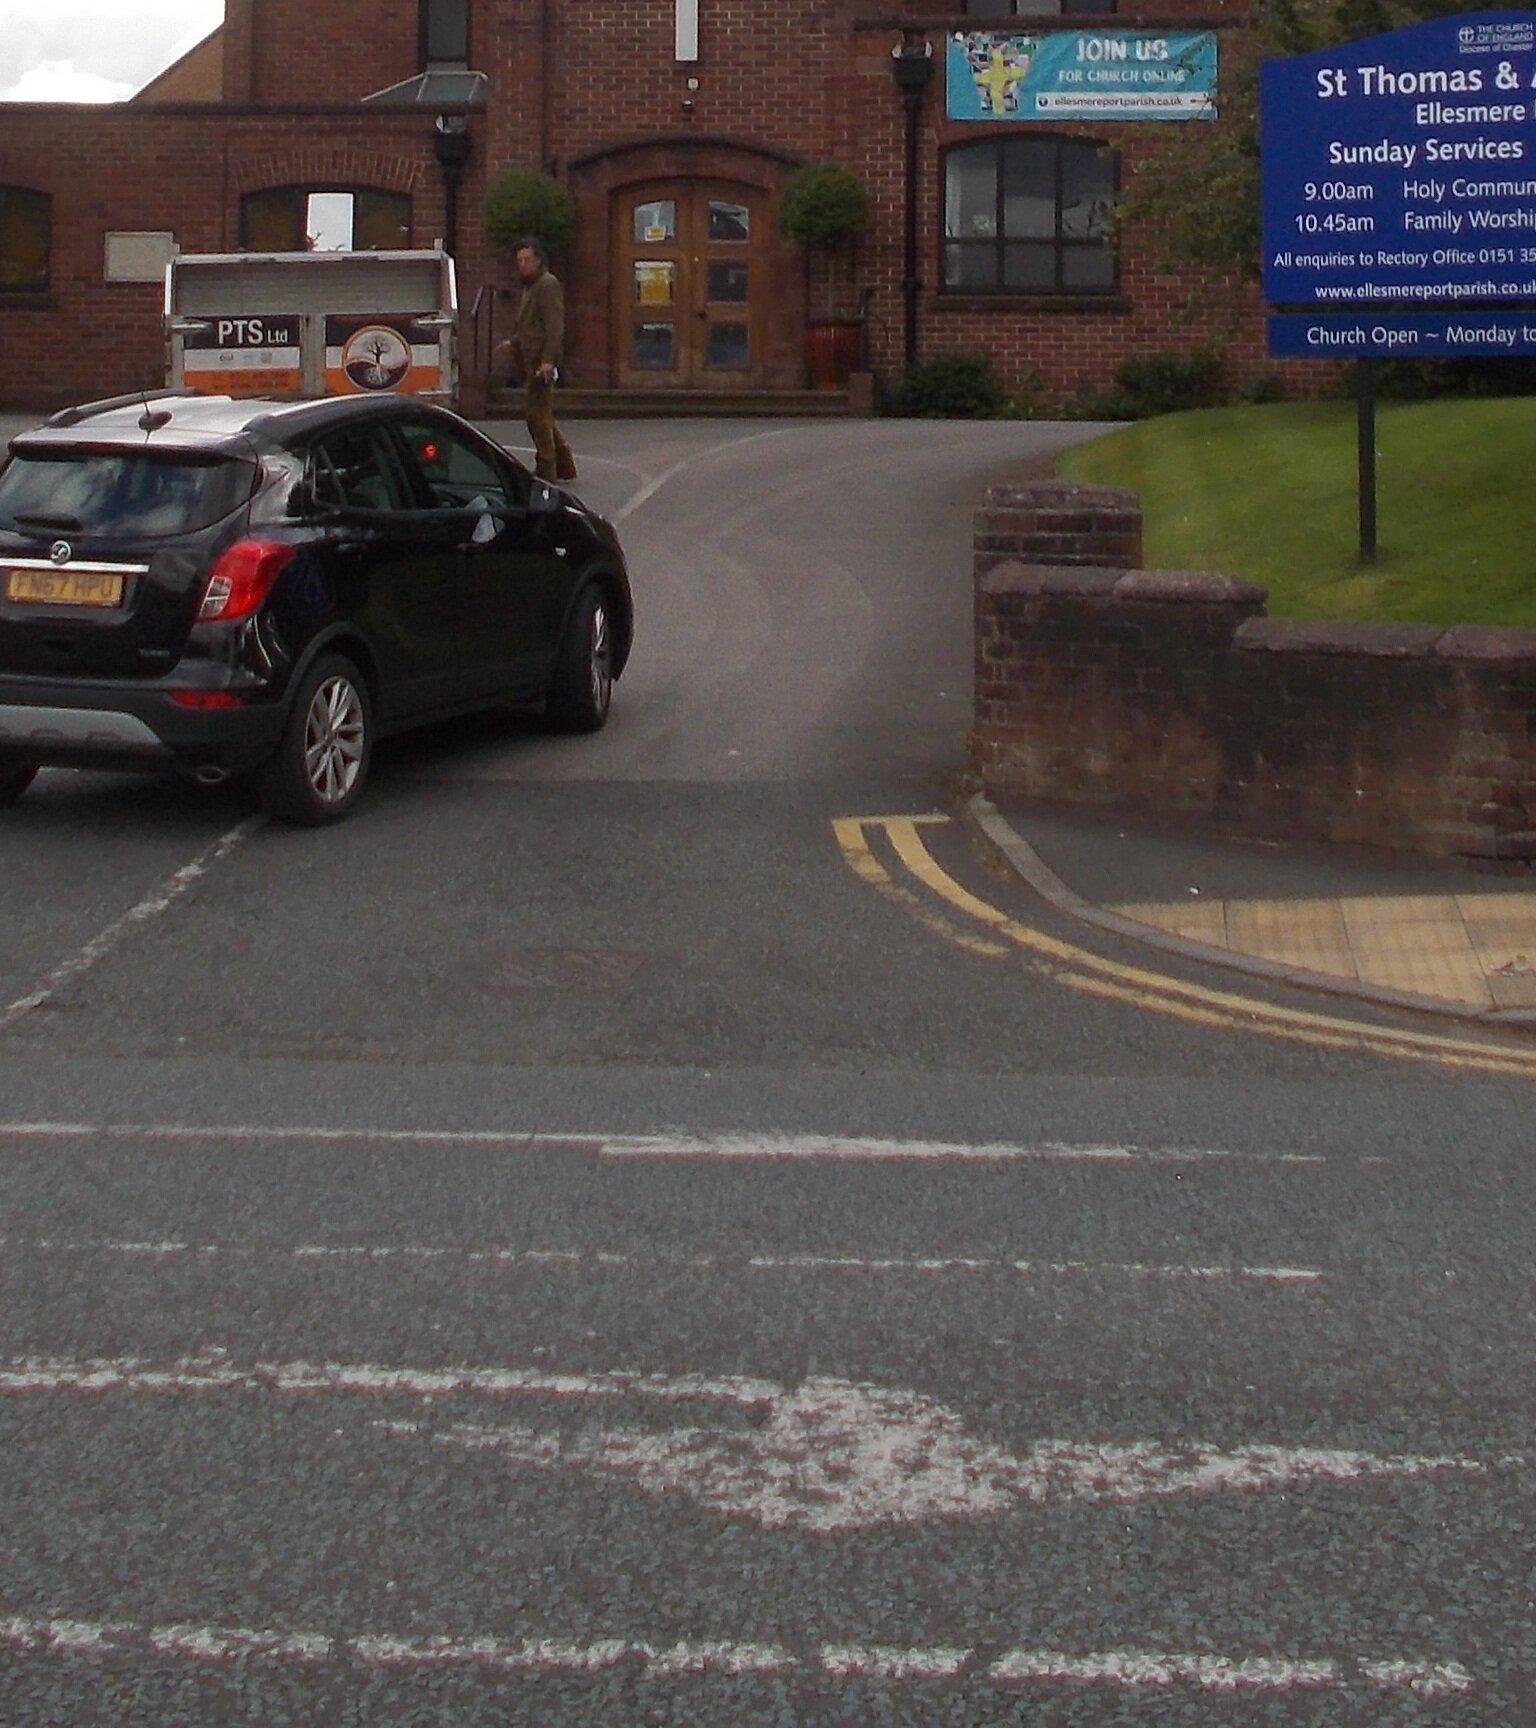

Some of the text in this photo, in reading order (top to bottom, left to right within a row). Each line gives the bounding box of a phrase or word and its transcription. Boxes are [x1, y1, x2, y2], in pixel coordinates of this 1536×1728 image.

[1076, 38, 1169, 62] JOIN US
[1058, 69, 1186, 83] FOR CHURCH ONLINE
[1316, 68, 1348, 97] St
[1357, 65, 1483, 95] Thomas
[1495, 61, 1520, 89] &
[1054, 96, 1183, 110] ellesmereportparish.co.uk
[1416, 101, 1526, 124] Ellesmere
[1329, 136, 1524, 168] Sunday Services
[1304, 181, 1374, 201] 9.00am
[1403, 178, 1446, 203] Holy
[1295, 213, 1375, 233] 10.45am
[1404, 209, 1463, 234] Family
[1273, 251, 1292, 267] All
[1295, 251, 1355, 270] enquiries
[1359, 251, 1374, 265] to
[1377, 250, 1429, 268] Rectory
[1432, 249, 1476, 265] Office
[1479, 248, 1515, 263] 0151
[217, 319, 288, 345] PTS Ltd
[1307, 326, 1366, 345] Church
[1371, 326, 1419, 348] Open
[1446, 324, 1517, 347] Monday
